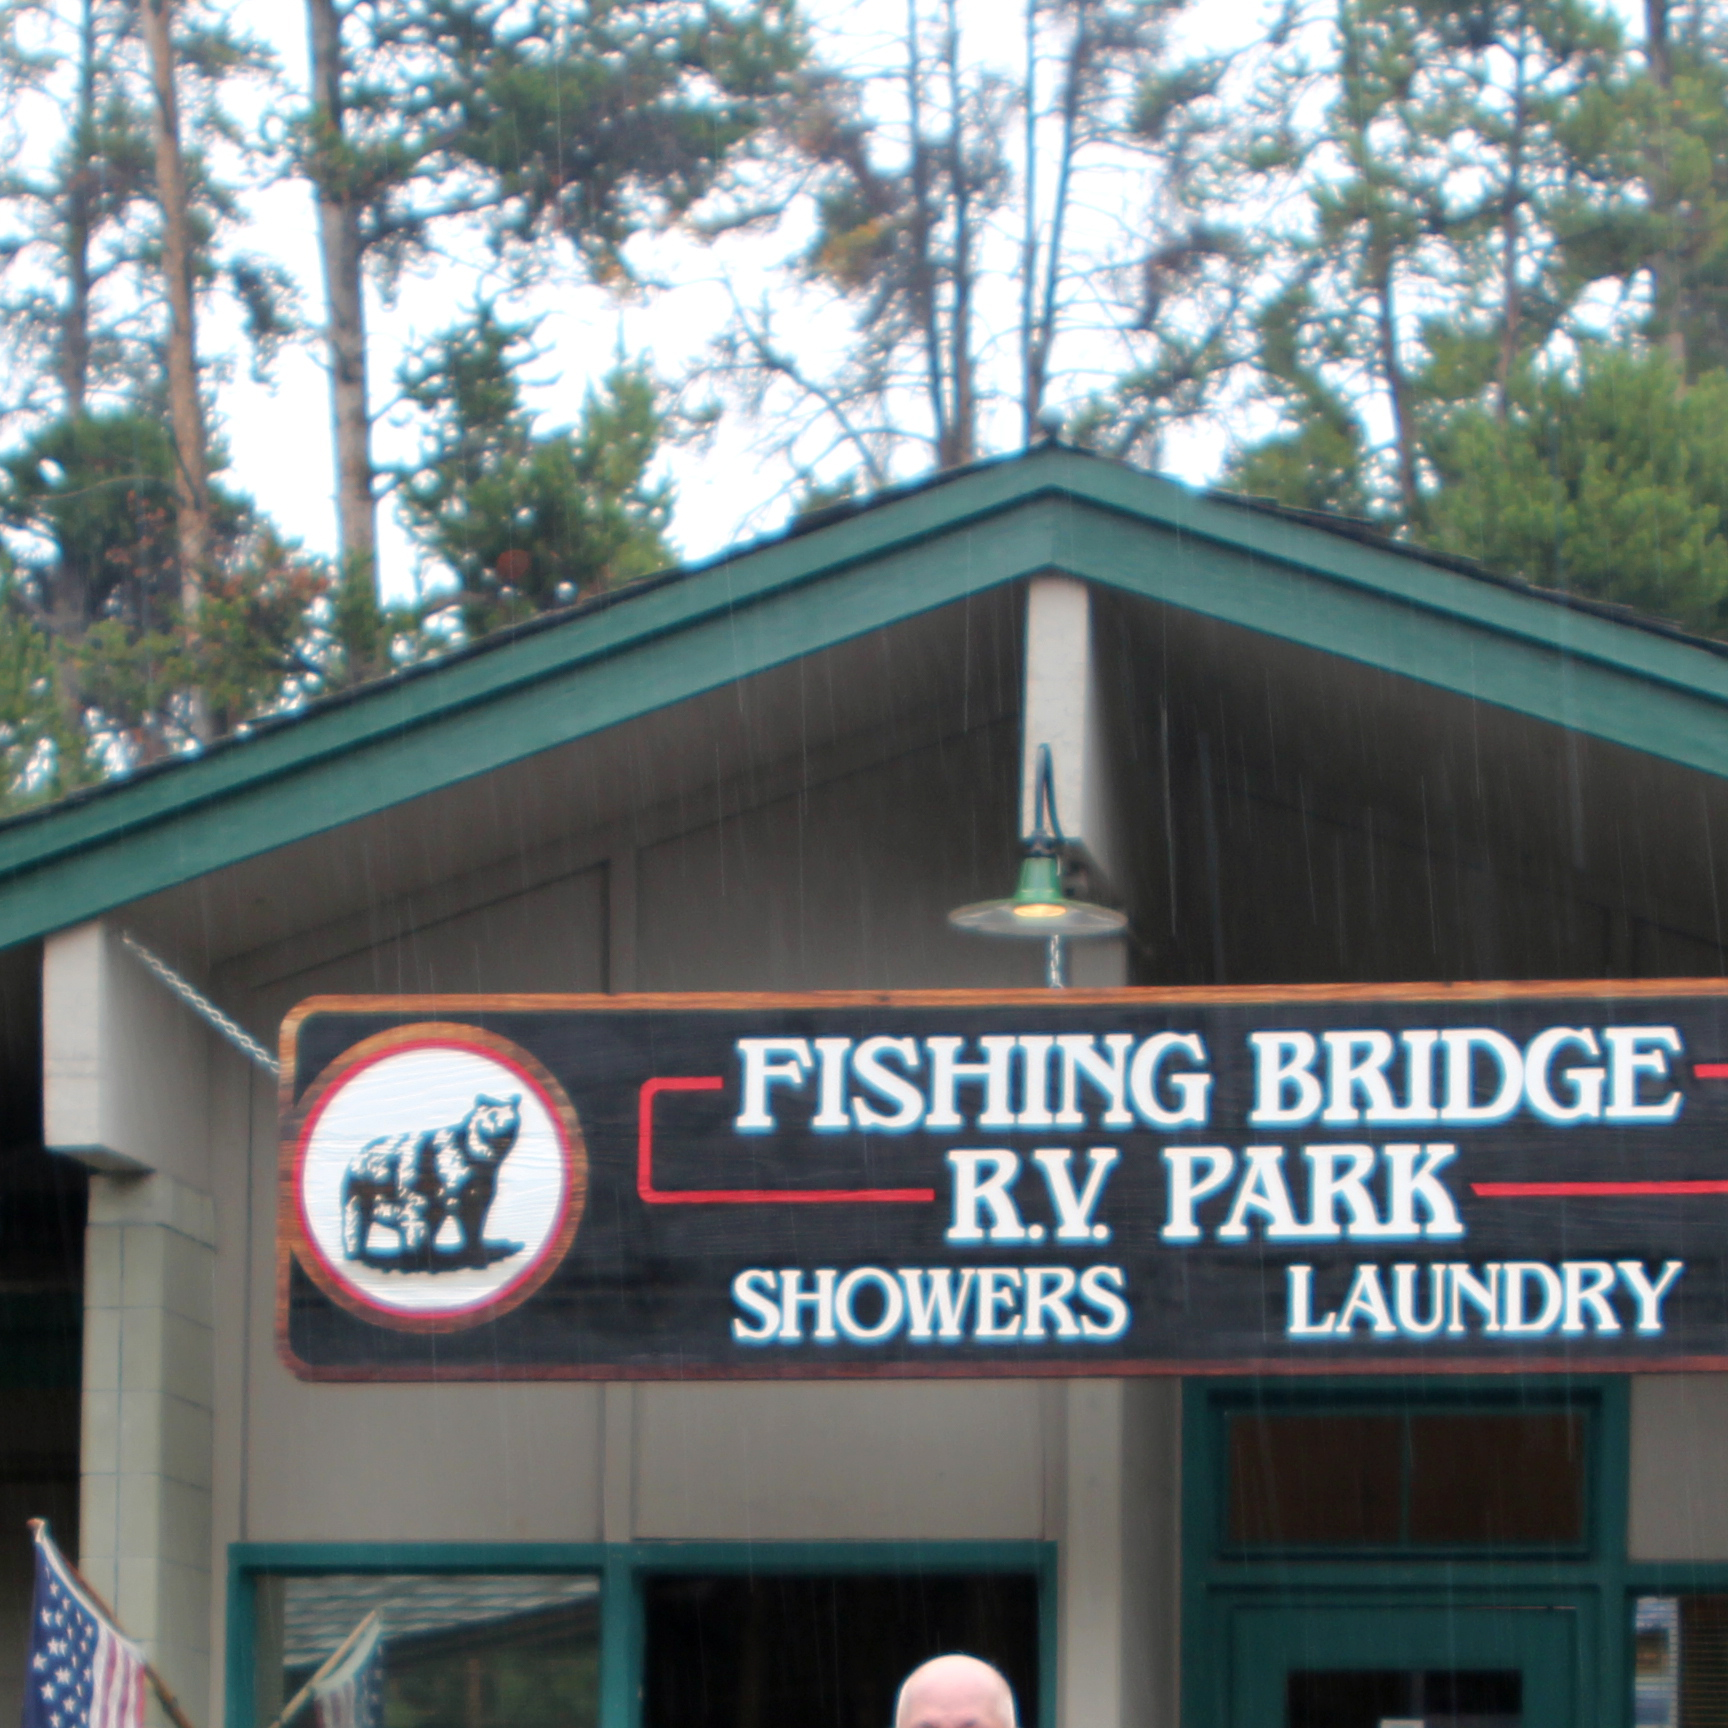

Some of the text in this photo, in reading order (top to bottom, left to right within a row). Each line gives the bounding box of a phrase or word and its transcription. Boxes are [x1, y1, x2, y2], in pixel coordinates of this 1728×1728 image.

[734, 1026, 1683, 1130] FISHING BRIDGE
[946, 1143, 1465, 1241] R.V. PARK
[733, 1260, 1683, 1341] SHOWERS LAUNDRY
